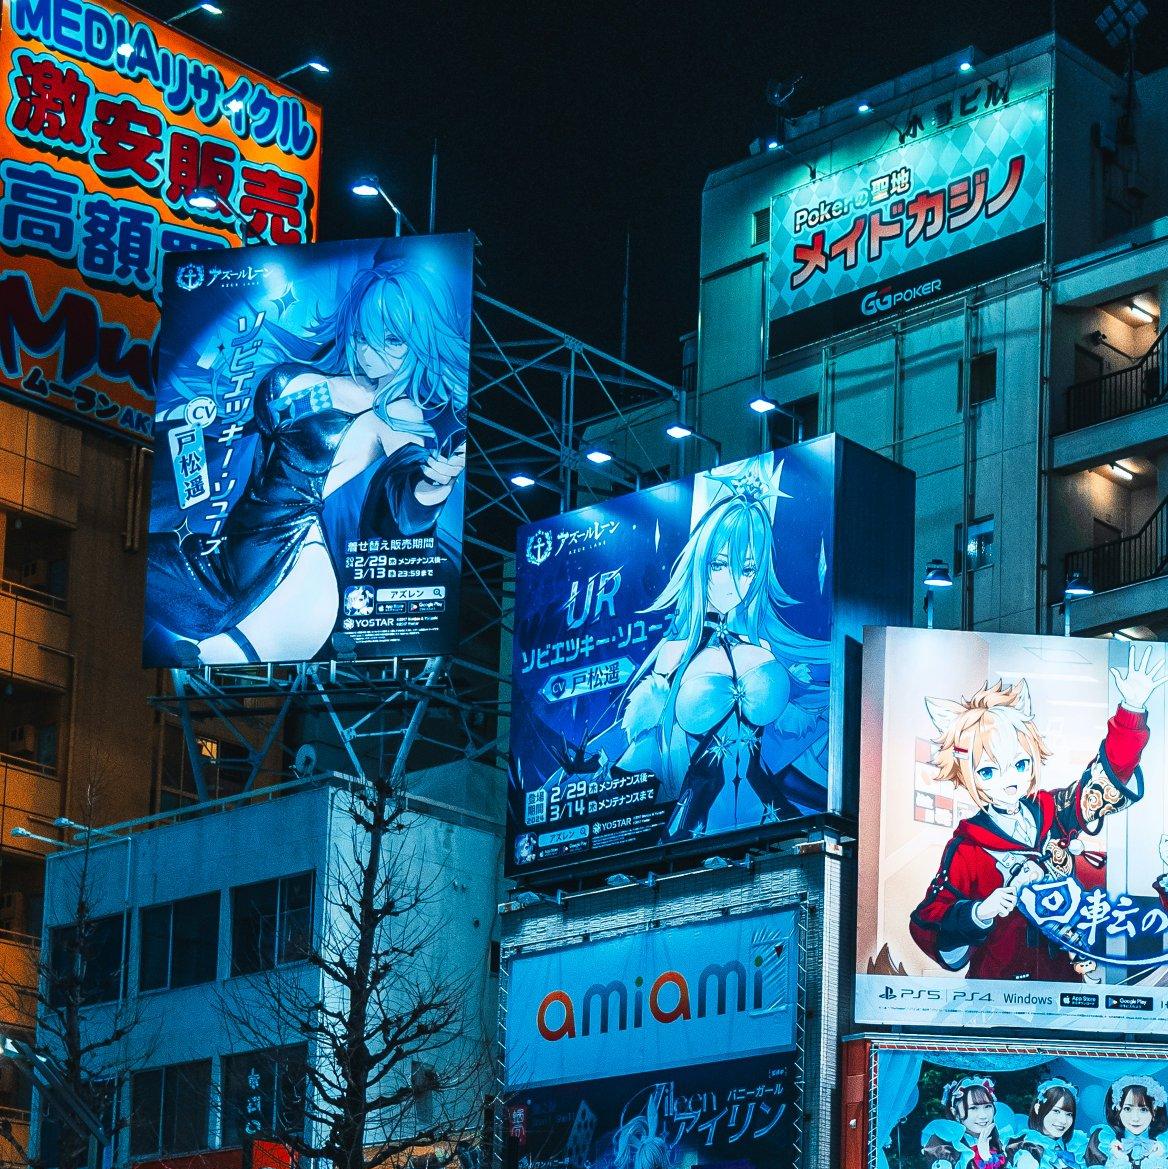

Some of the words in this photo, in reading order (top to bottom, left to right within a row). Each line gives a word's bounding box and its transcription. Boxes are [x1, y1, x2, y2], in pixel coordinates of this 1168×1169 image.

[16, 56, 304, 247] 激安販売
[2, 163, 228, 286] 高額
[791, 154, 1025, 287] メイドカジノ
[191, 403, 216, 421] CV
[562, 566, 622, 629] UR
[355, 618, 394, 628] YOSTAR
[549, 799, 586, 822] 3/14
[550, 780, 587, 804] 2/29
[537, 954, 763, 1042] amiami
[900, 988, 942, 1000] PS5
[952, 990, 993, 1003] PS4
[1003, 992, 1053, 1006] Windows
